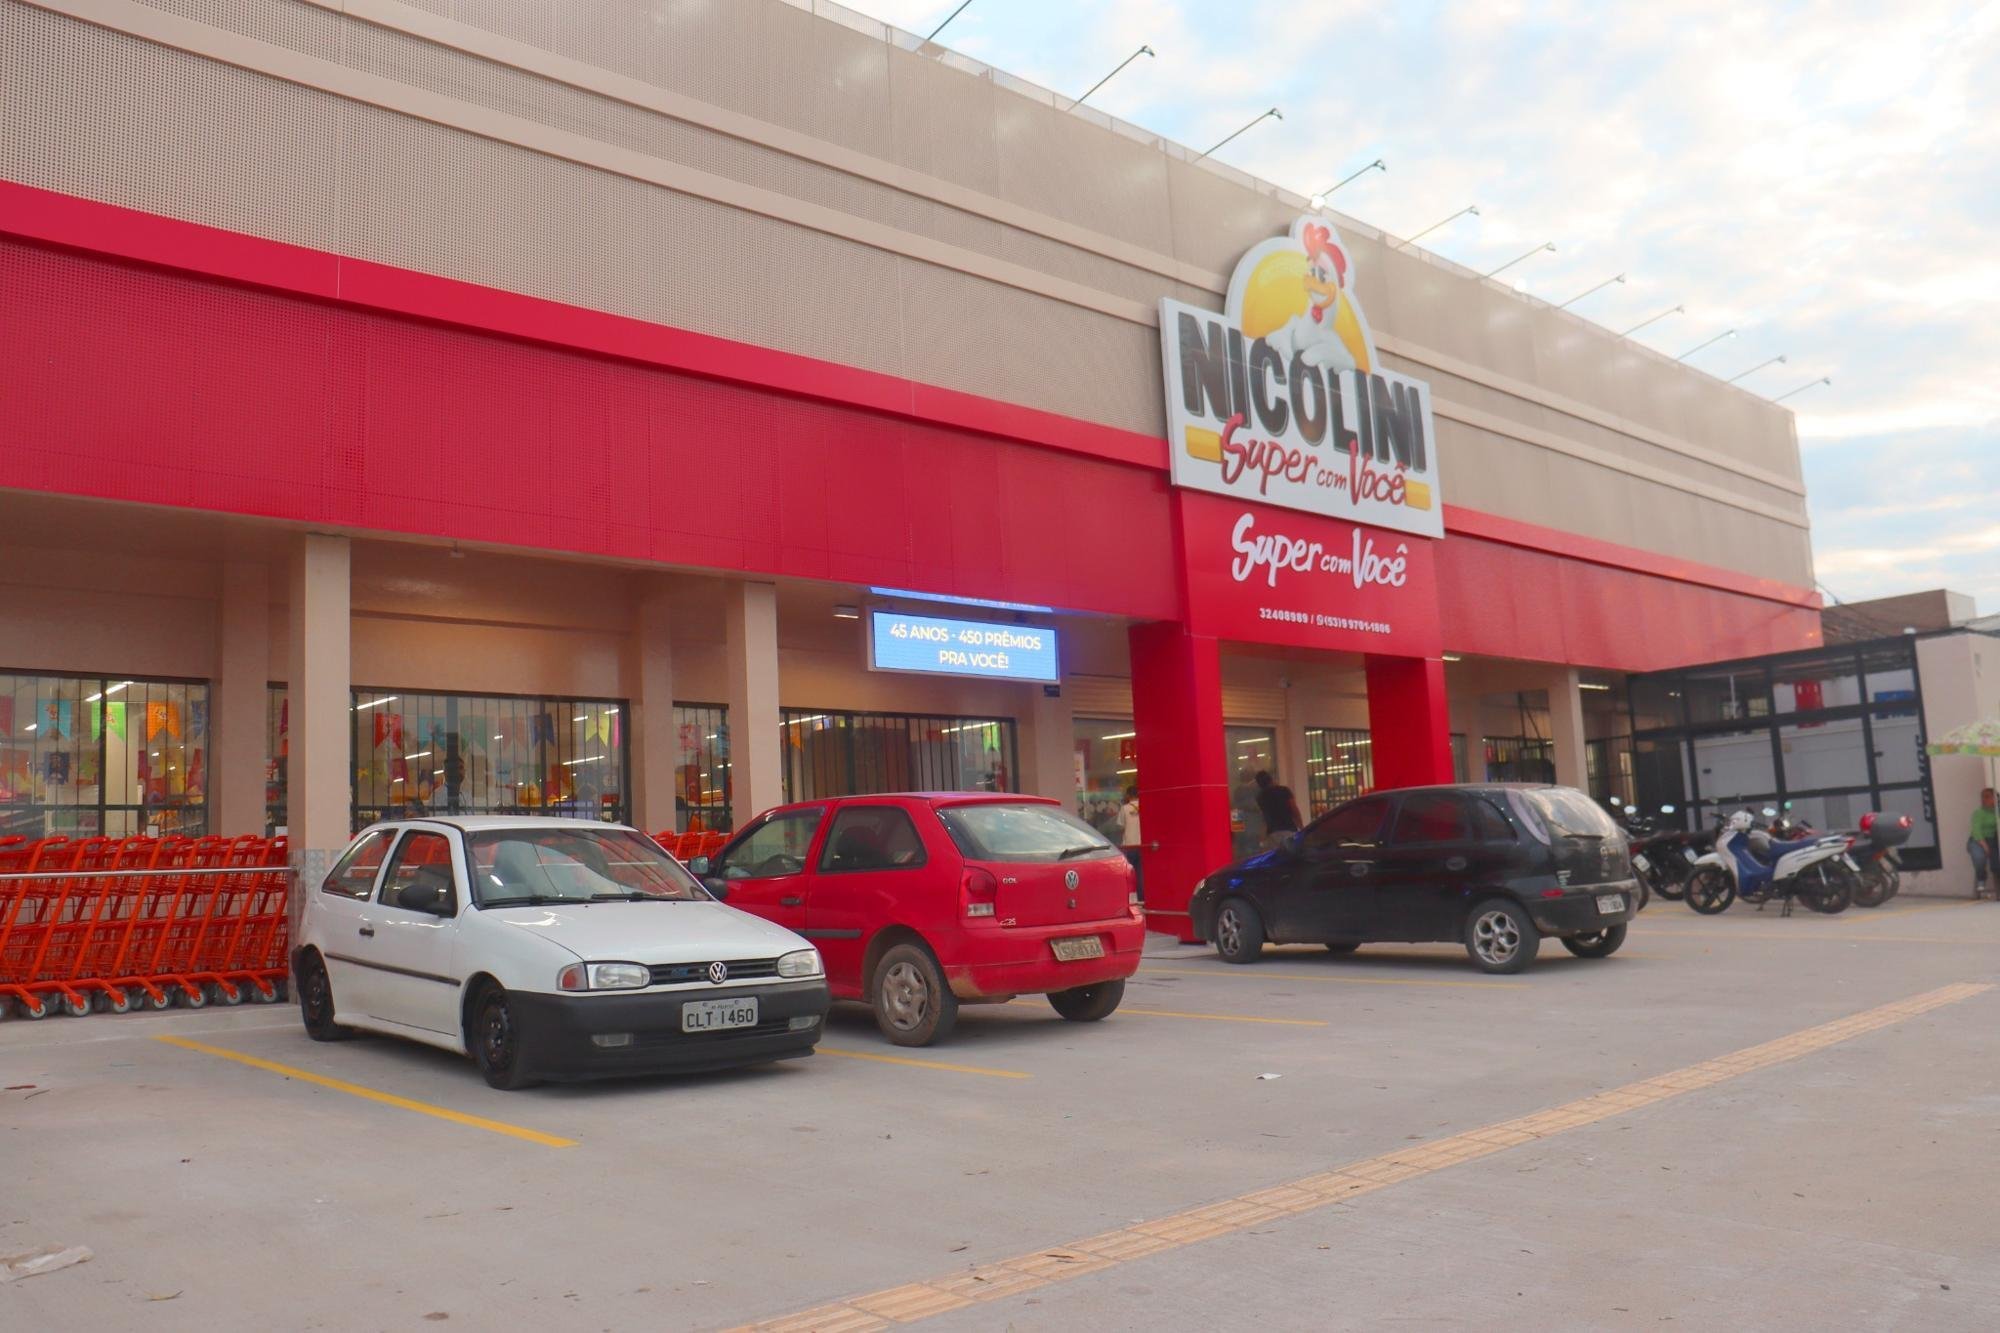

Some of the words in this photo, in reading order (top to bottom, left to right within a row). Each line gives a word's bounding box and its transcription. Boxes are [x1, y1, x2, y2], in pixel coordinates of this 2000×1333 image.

[1178, 311, 1427, 473] NICOLINI
[1220, 412, 1318, 495] Super
[1317, 468, 1347, 490] com
[1349, 439, 1408, 505] Você
[1231, 513, 1322, 587] Super
[1320, 552, 1352, 575] com
[1352, 528, 1409, 589] Você
[890, 623, 907, 639] 45
[910, 625, 949, 642] ANOS
[958, 629, 983, 645] 450
[985, 630, 1042, 650] PRÊMIOS
[939, 650, 968, 666] PRA
[969, 651, 1009, 669] VOCÊ!
[687, 1011, 713, 1028] CLT
[721, 1008, 754, 1024] 1460
